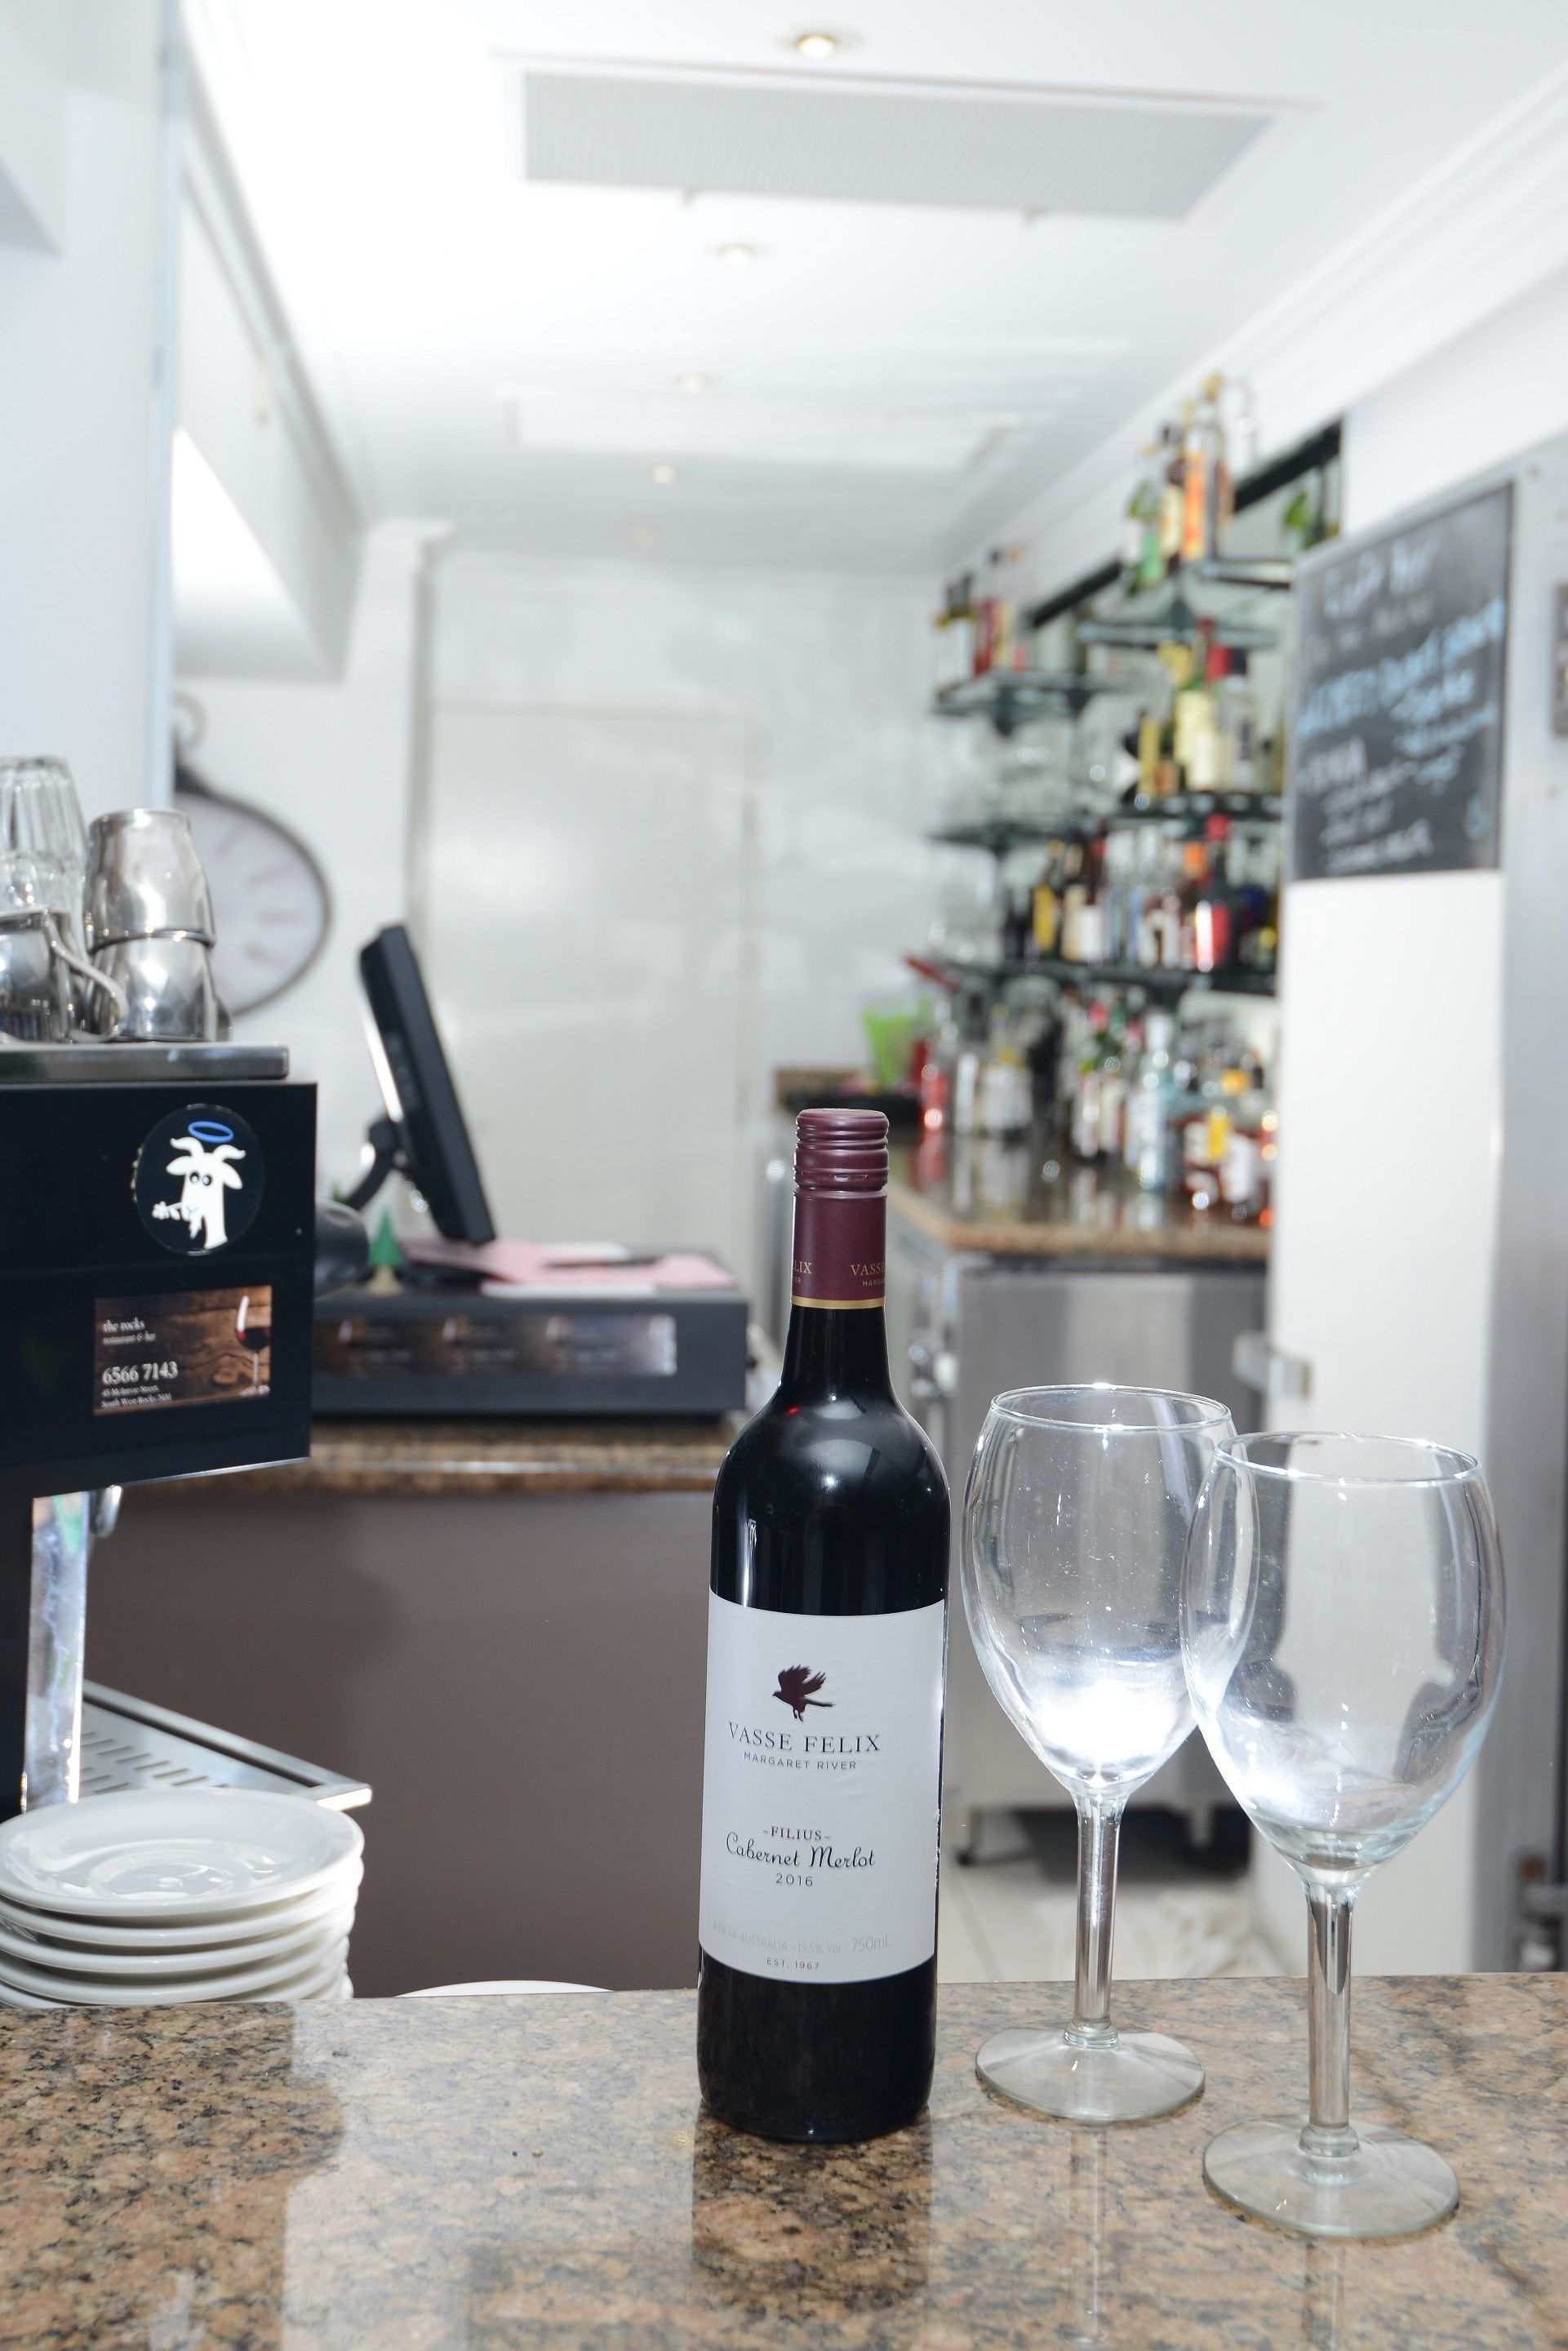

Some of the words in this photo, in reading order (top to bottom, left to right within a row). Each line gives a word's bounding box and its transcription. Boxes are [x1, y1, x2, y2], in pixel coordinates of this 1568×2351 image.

[793, 1260, 812, 1274] LIX
[102, 1365, 140, 1386] 6566
[141, 1361, 179, 1380] 7143
[729, 1722, 793, 1751] VASSE
[804, 1734, 881, 1753] FELIX
[744, 1751, 811, 1769] MARGARET
[817, 1761, 856, 1770] RIVER
[726, 1831, 801, 1867] Cabernet
[809, 1846, 875, 1869] Merlot
[775, 1873, 813, 1887] 2016
[712, 1919, 727, 1935] WINE
[728, 1927, 739, 1940] OF
[740, 1931, 788, 1952] AUSTRALIA
[798, 1939, 823, 1954] 13.5%
[827, 1942, 842, 1954] Vol
[851, 1933, 892, 1953] 750mL
[766, 1957, 789, 1968] EST.
[795, 1959, 820, 1970] 1967
